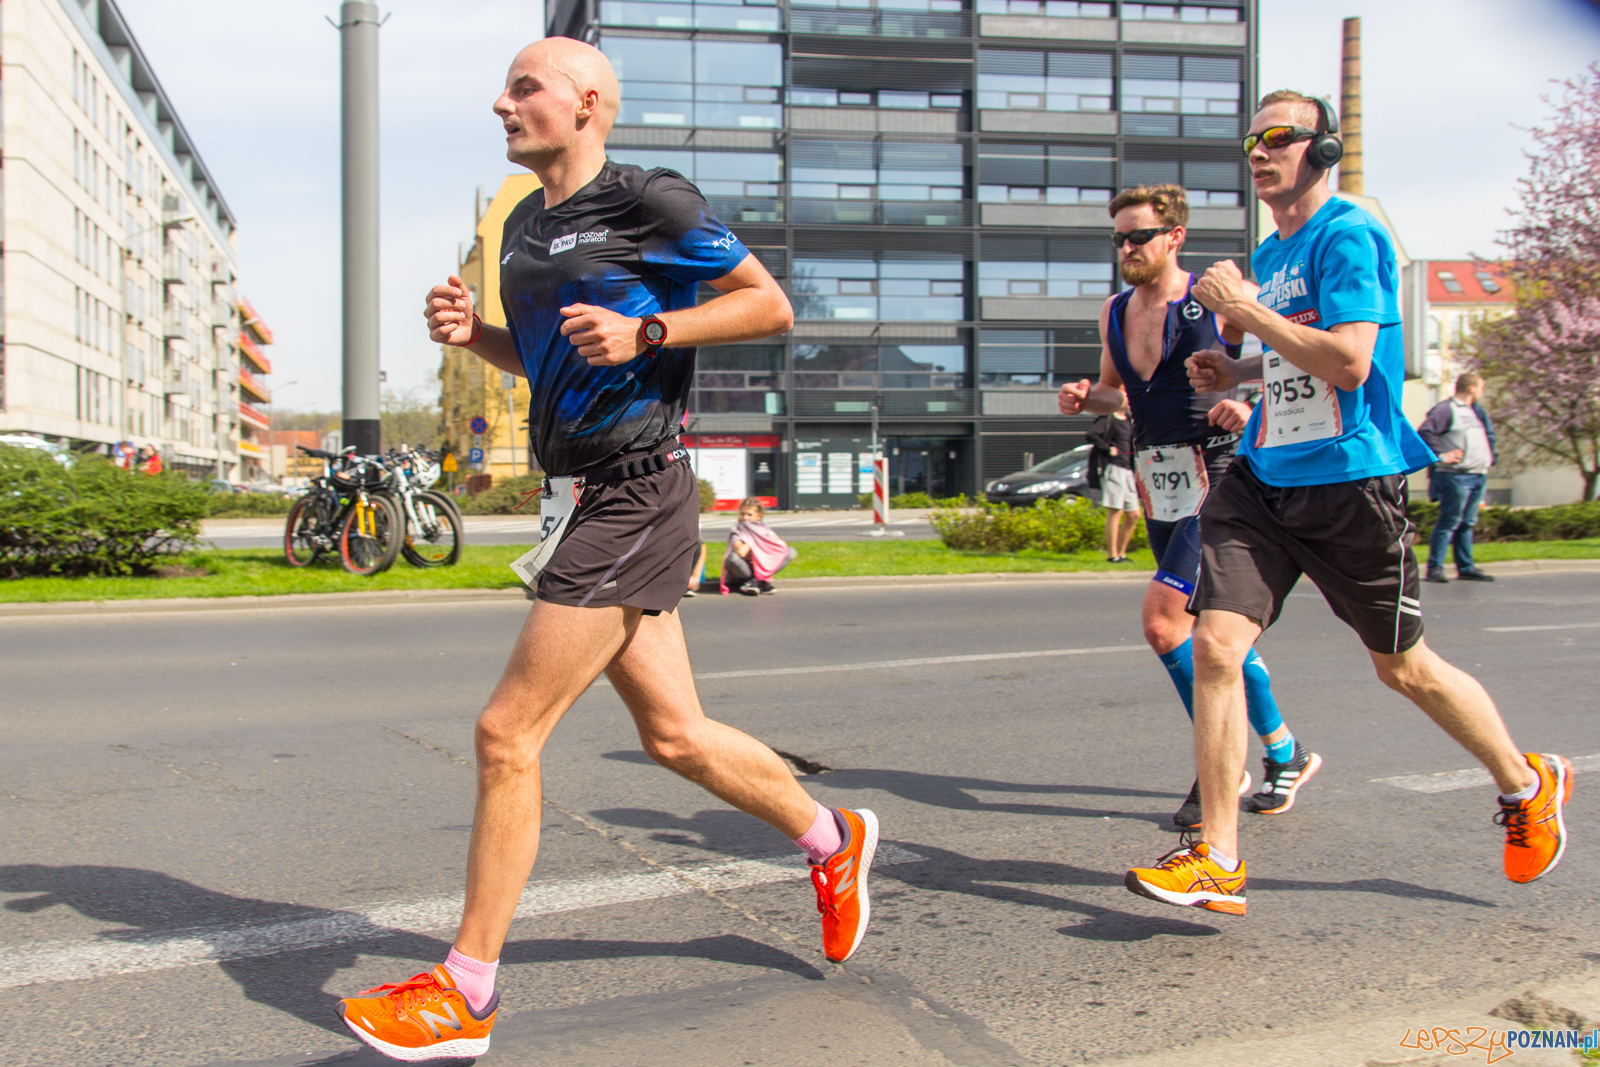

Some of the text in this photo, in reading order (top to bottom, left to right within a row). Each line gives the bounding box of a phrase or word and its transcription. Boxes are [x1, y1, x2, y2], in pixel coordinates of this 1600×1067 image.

[560, 237, 575, 248] PKO
[577, 236, 607, 244] maraton
[1266, 374, 1316, 406] 1953
[471, 450, 482, 461] P
[1152, 471, 1191, 491] 8791
